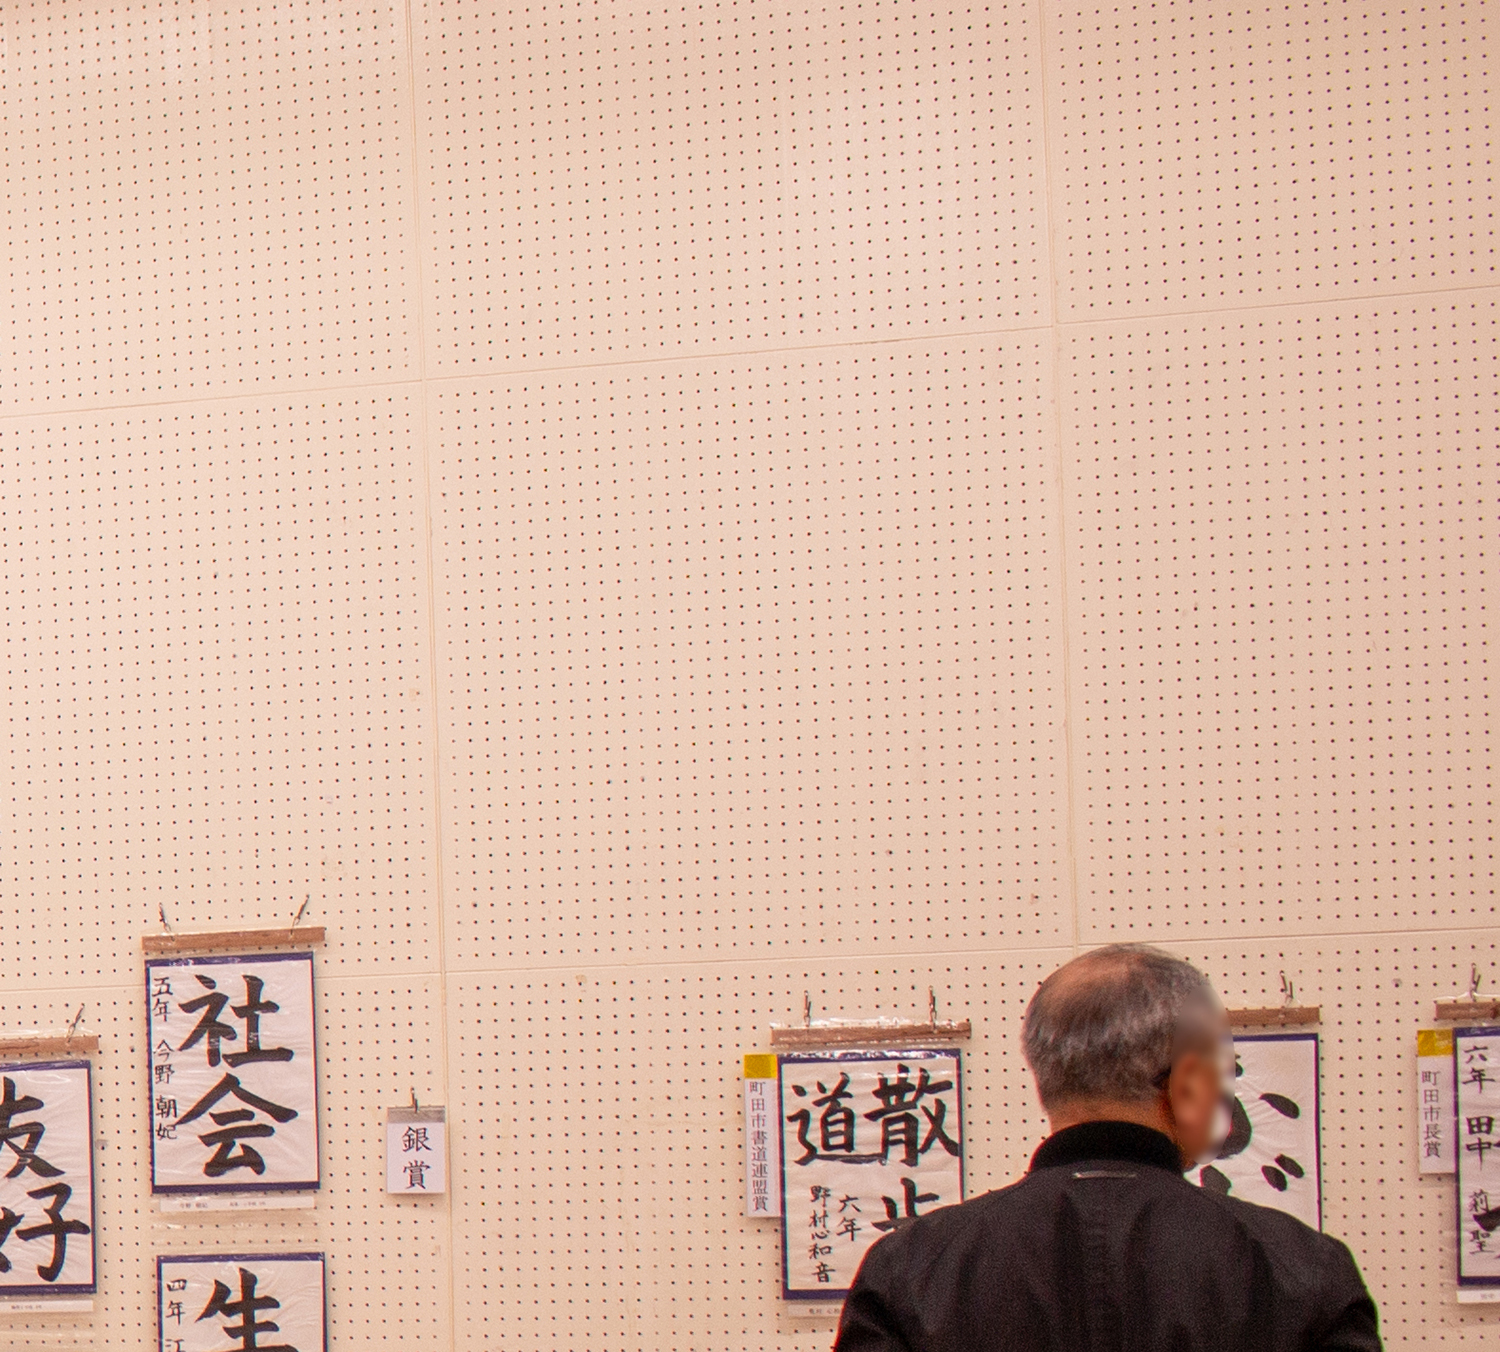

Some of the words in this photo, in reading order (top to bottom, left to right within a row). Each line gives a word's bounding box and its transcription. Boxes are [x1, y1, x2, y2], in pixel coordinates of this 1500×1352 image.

[152, 976, 174, 1022] 五年
[173, 974, 298, 1177] 社会
[1462, 1046, 1496, 1094] 六年
[786, 1071, 888, 1167] 道
[1421, 1070, 1442, 1159] 町田市長賞
[1466, 1115, 1495, 1172] 田中
[401, 1125, 433, 1190] 銀賞
[749, 1081, 768, 1212] 町田市書道連盟賞
[836, 1193, 862, 1242] 六年
[165, 1278, 187, 1325] 四年
